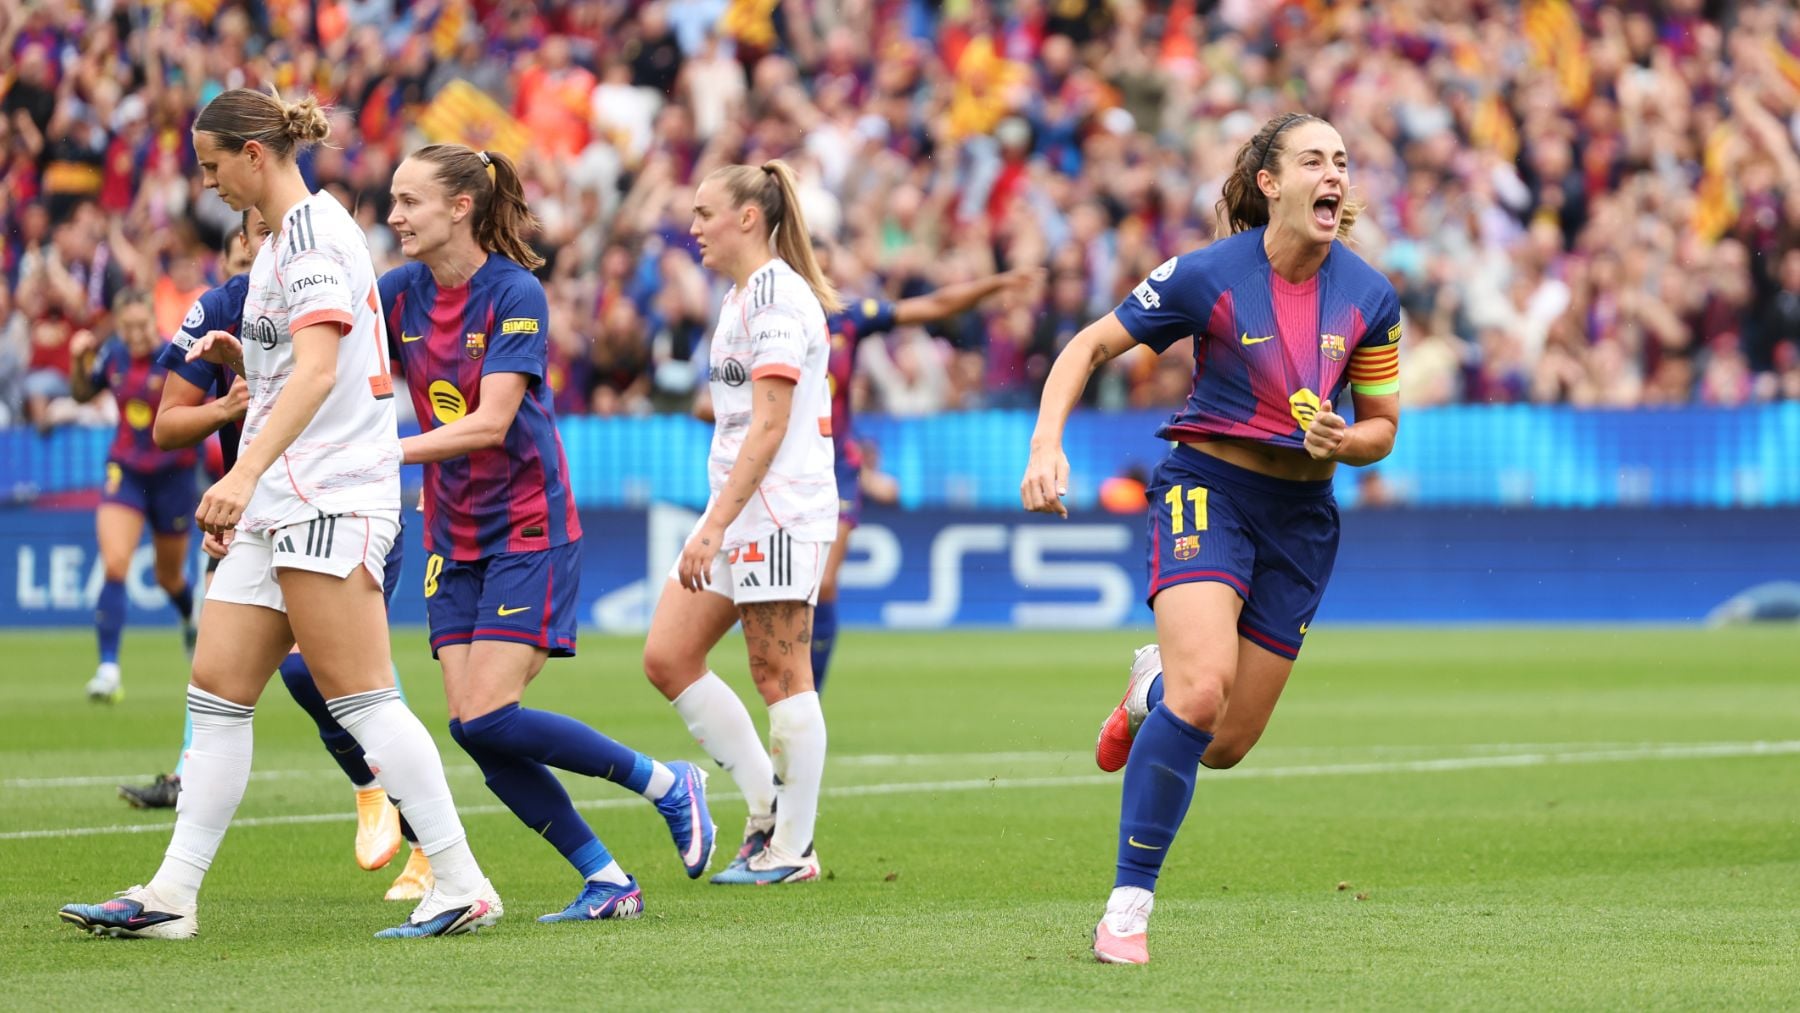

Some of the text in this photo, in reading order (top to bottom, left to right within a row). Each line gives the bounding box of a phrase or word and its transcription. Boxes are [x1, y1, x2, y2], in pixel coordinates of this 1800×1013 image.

[502, 320, 539, 333] BIMBO
[752, 328, 791, 344] ITACHI
[1165, 484, 1208, 535] 11
[838, 524, 1134, 628] PS5
